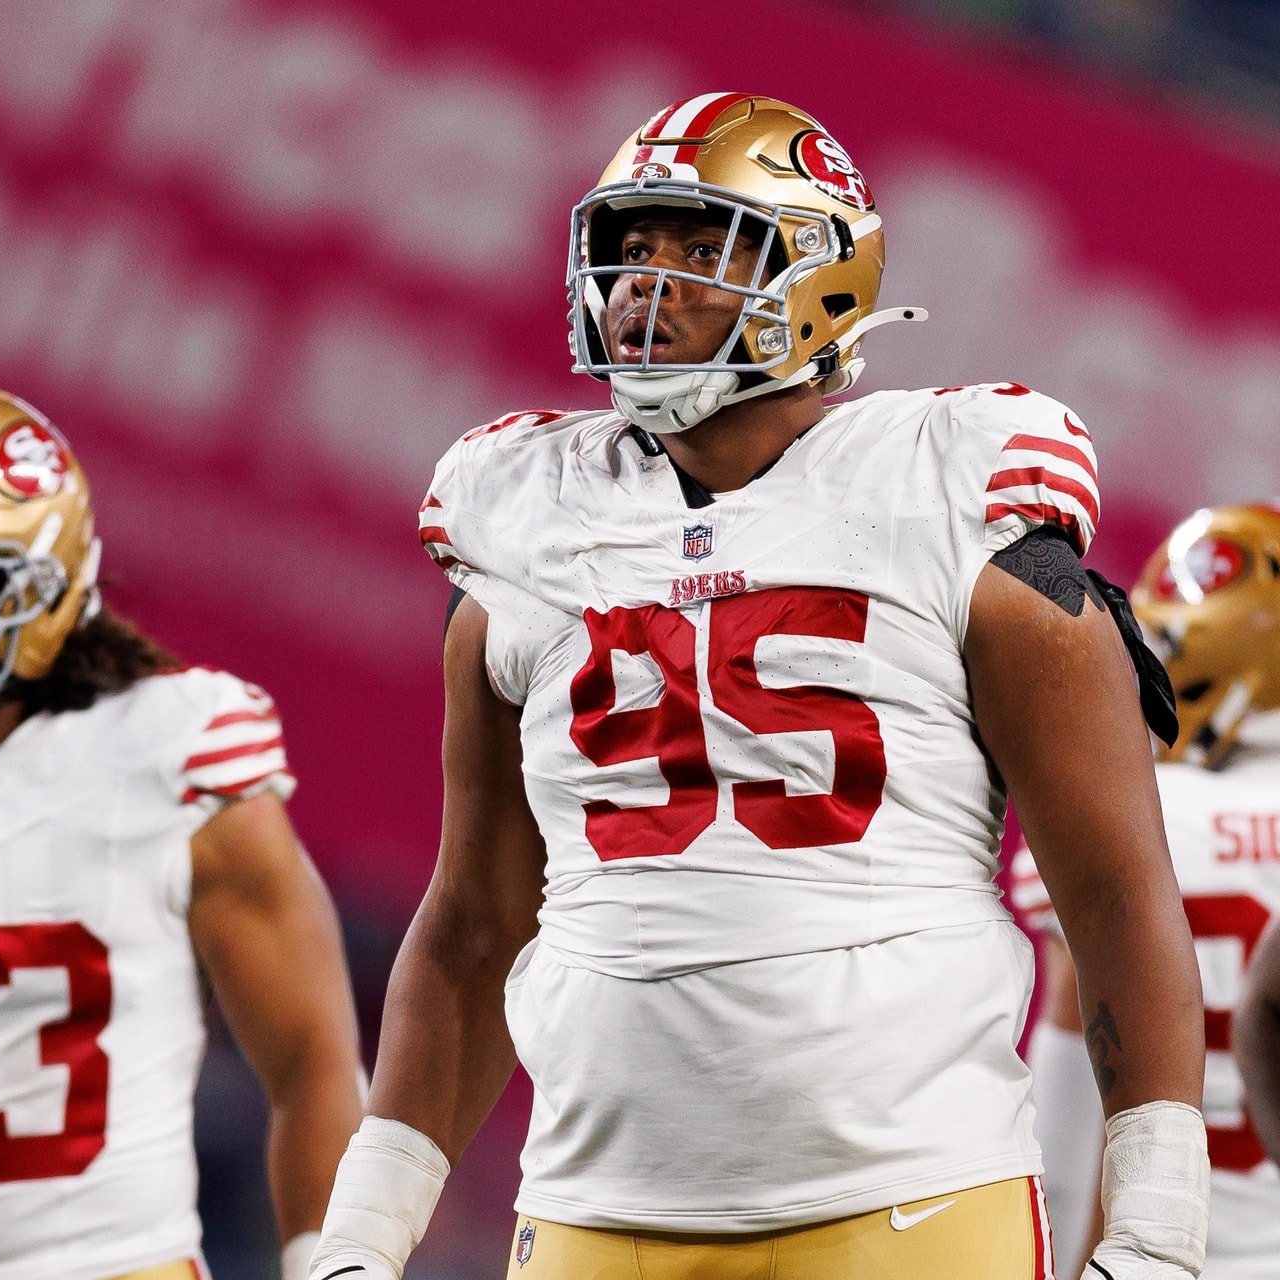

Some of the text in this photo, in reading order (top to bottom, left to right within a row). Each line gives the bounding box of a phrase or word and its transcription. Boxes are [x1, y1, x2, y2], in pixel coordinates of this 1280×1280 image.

[686, 538, 709, 555] NFL
[669, 570, 747, 606] 49ERS
[569, 586, 888, 862] 95
